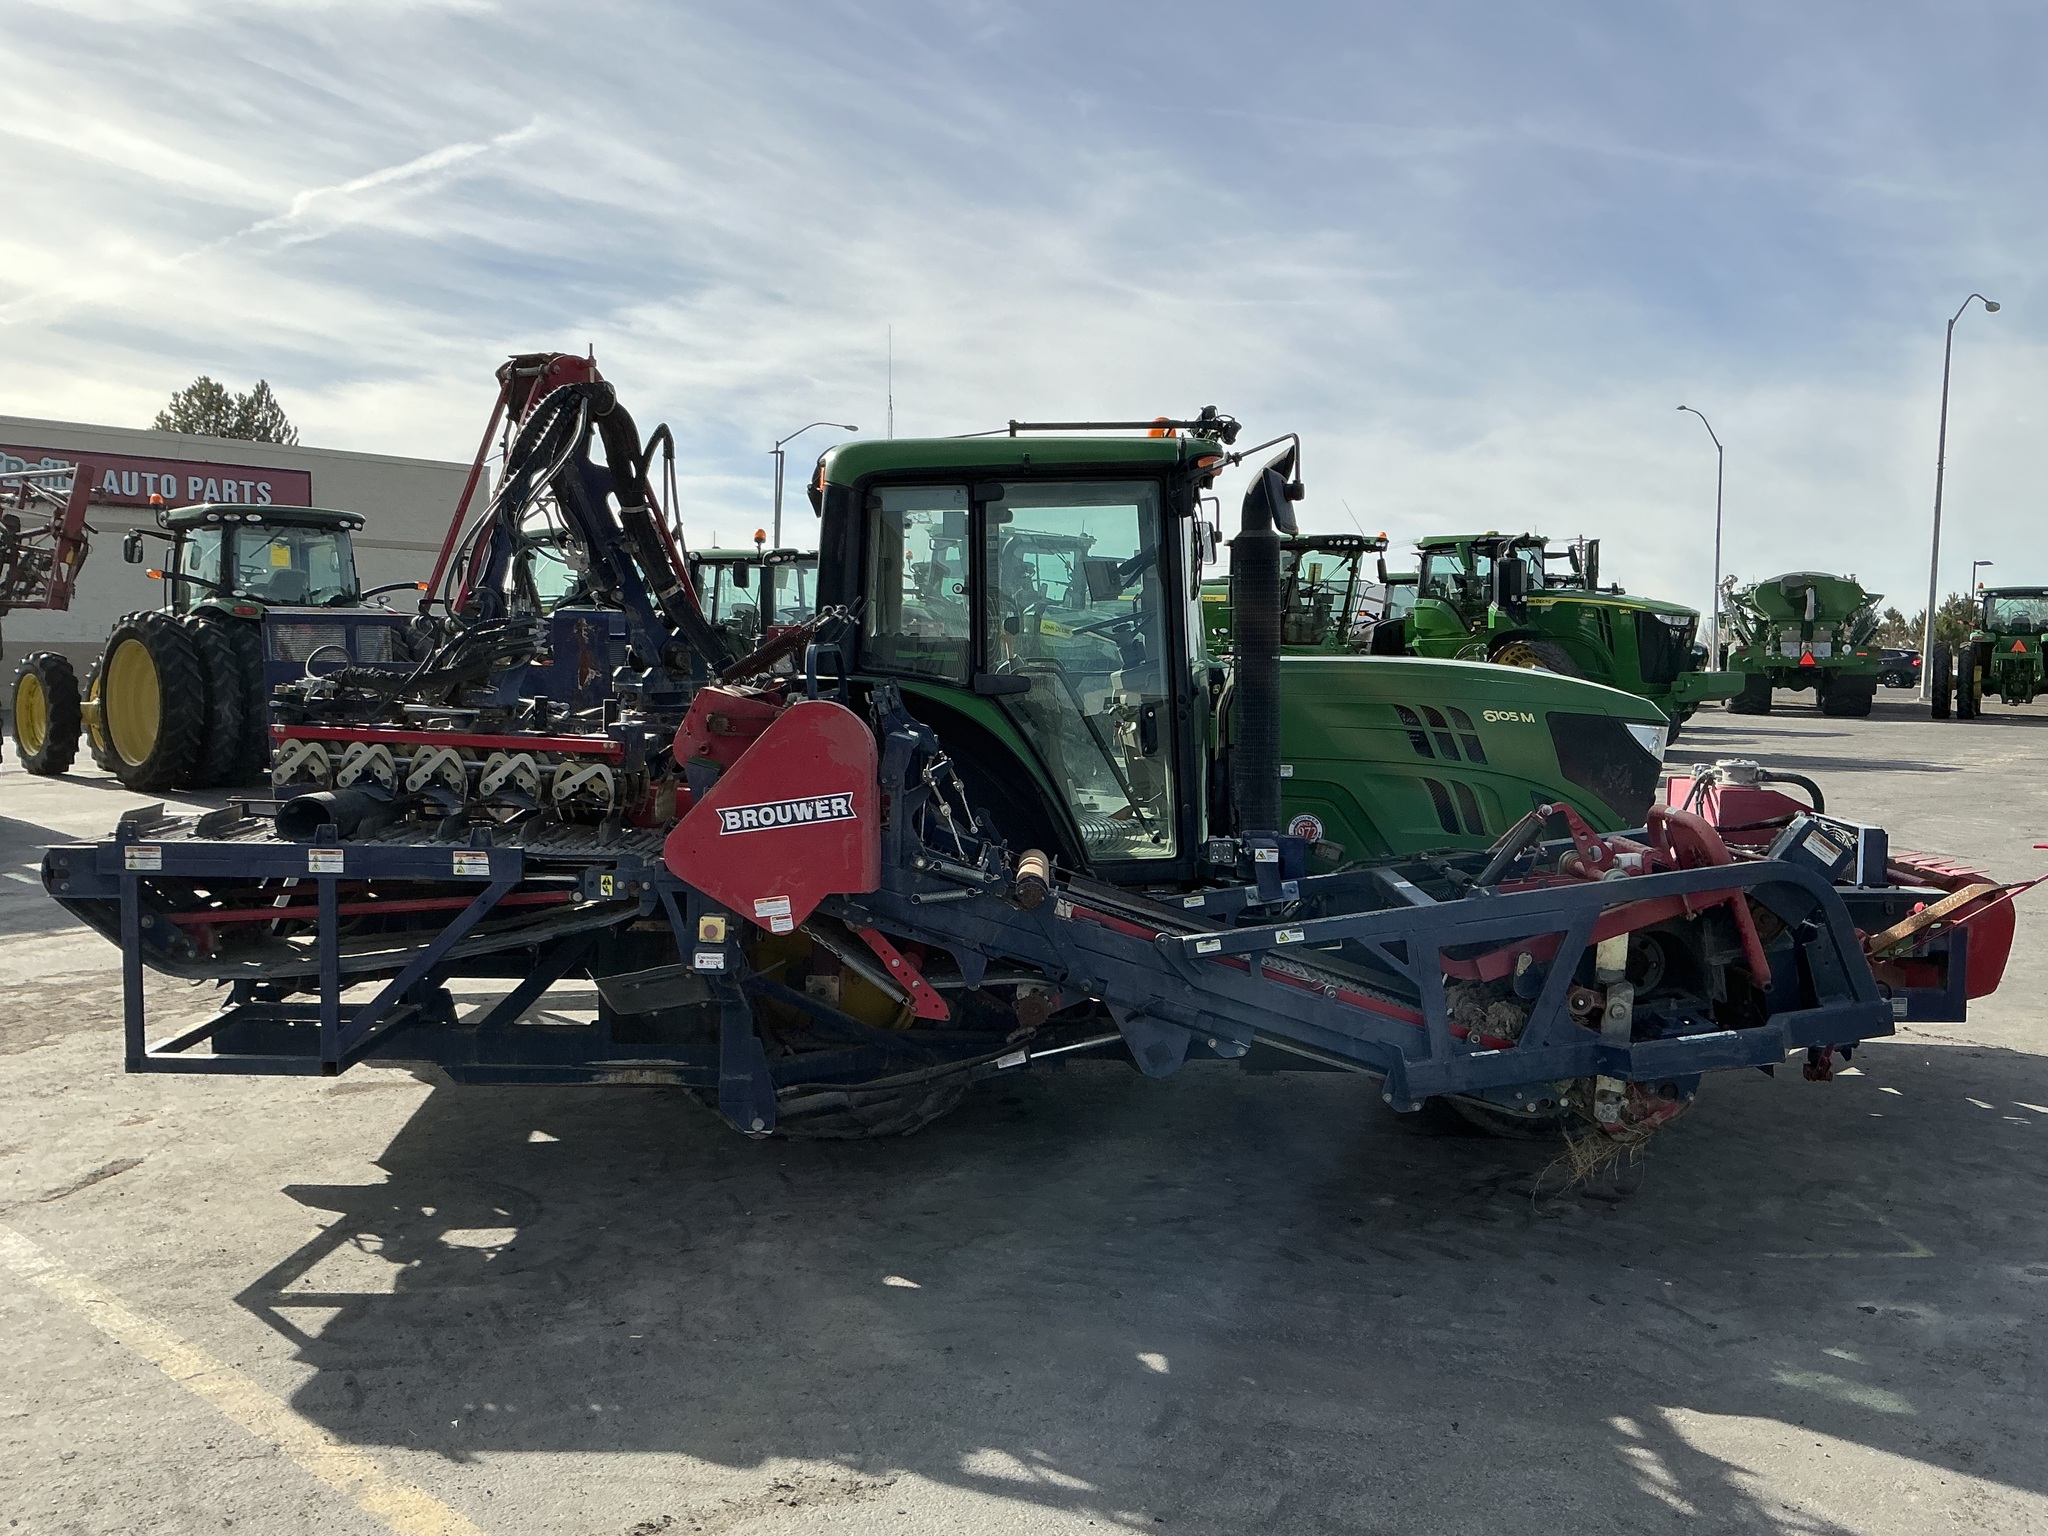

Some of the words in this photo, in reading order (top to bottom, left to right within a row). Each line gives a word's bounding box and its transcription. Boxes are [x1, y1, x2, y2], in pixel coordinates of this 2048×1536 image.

[102, 469, 177, 499] AUTO
[188, 476, 272, 506] PARTS
[724, 797, 849, 830] BROUWER
[1294, 826, 1317, 840] 1972
